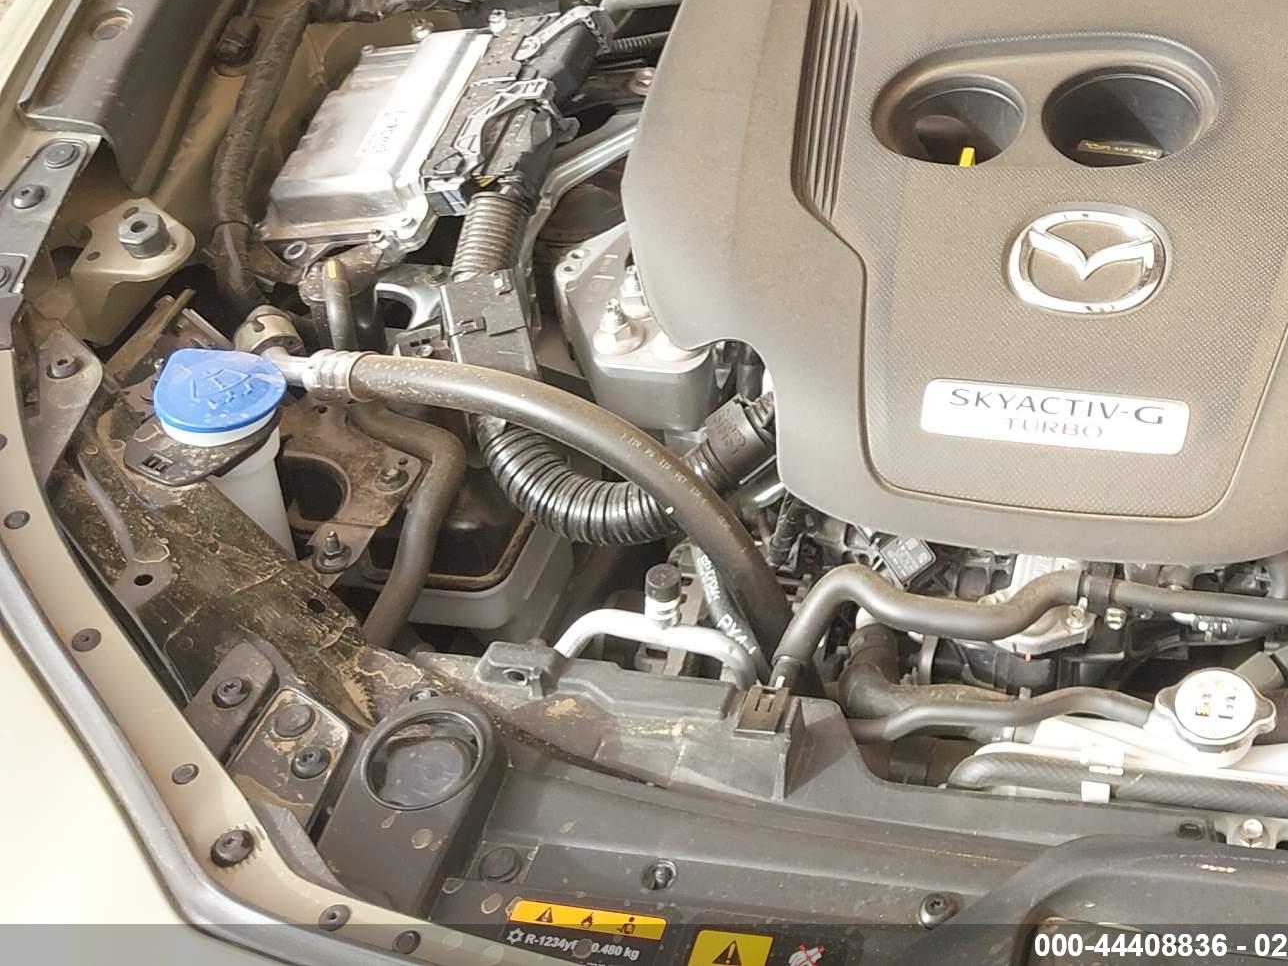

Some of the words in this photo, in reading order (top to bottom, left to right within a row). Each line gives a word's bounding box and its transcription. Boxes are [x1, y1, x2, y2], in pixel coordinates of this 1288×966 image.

[949, 388, 1165, 425] SKYACTIV-G
[1006, 417, 1103, 439] TURBO
[591, 942, 622, 956] 0.480
[623, 946, 640, 961] kg
